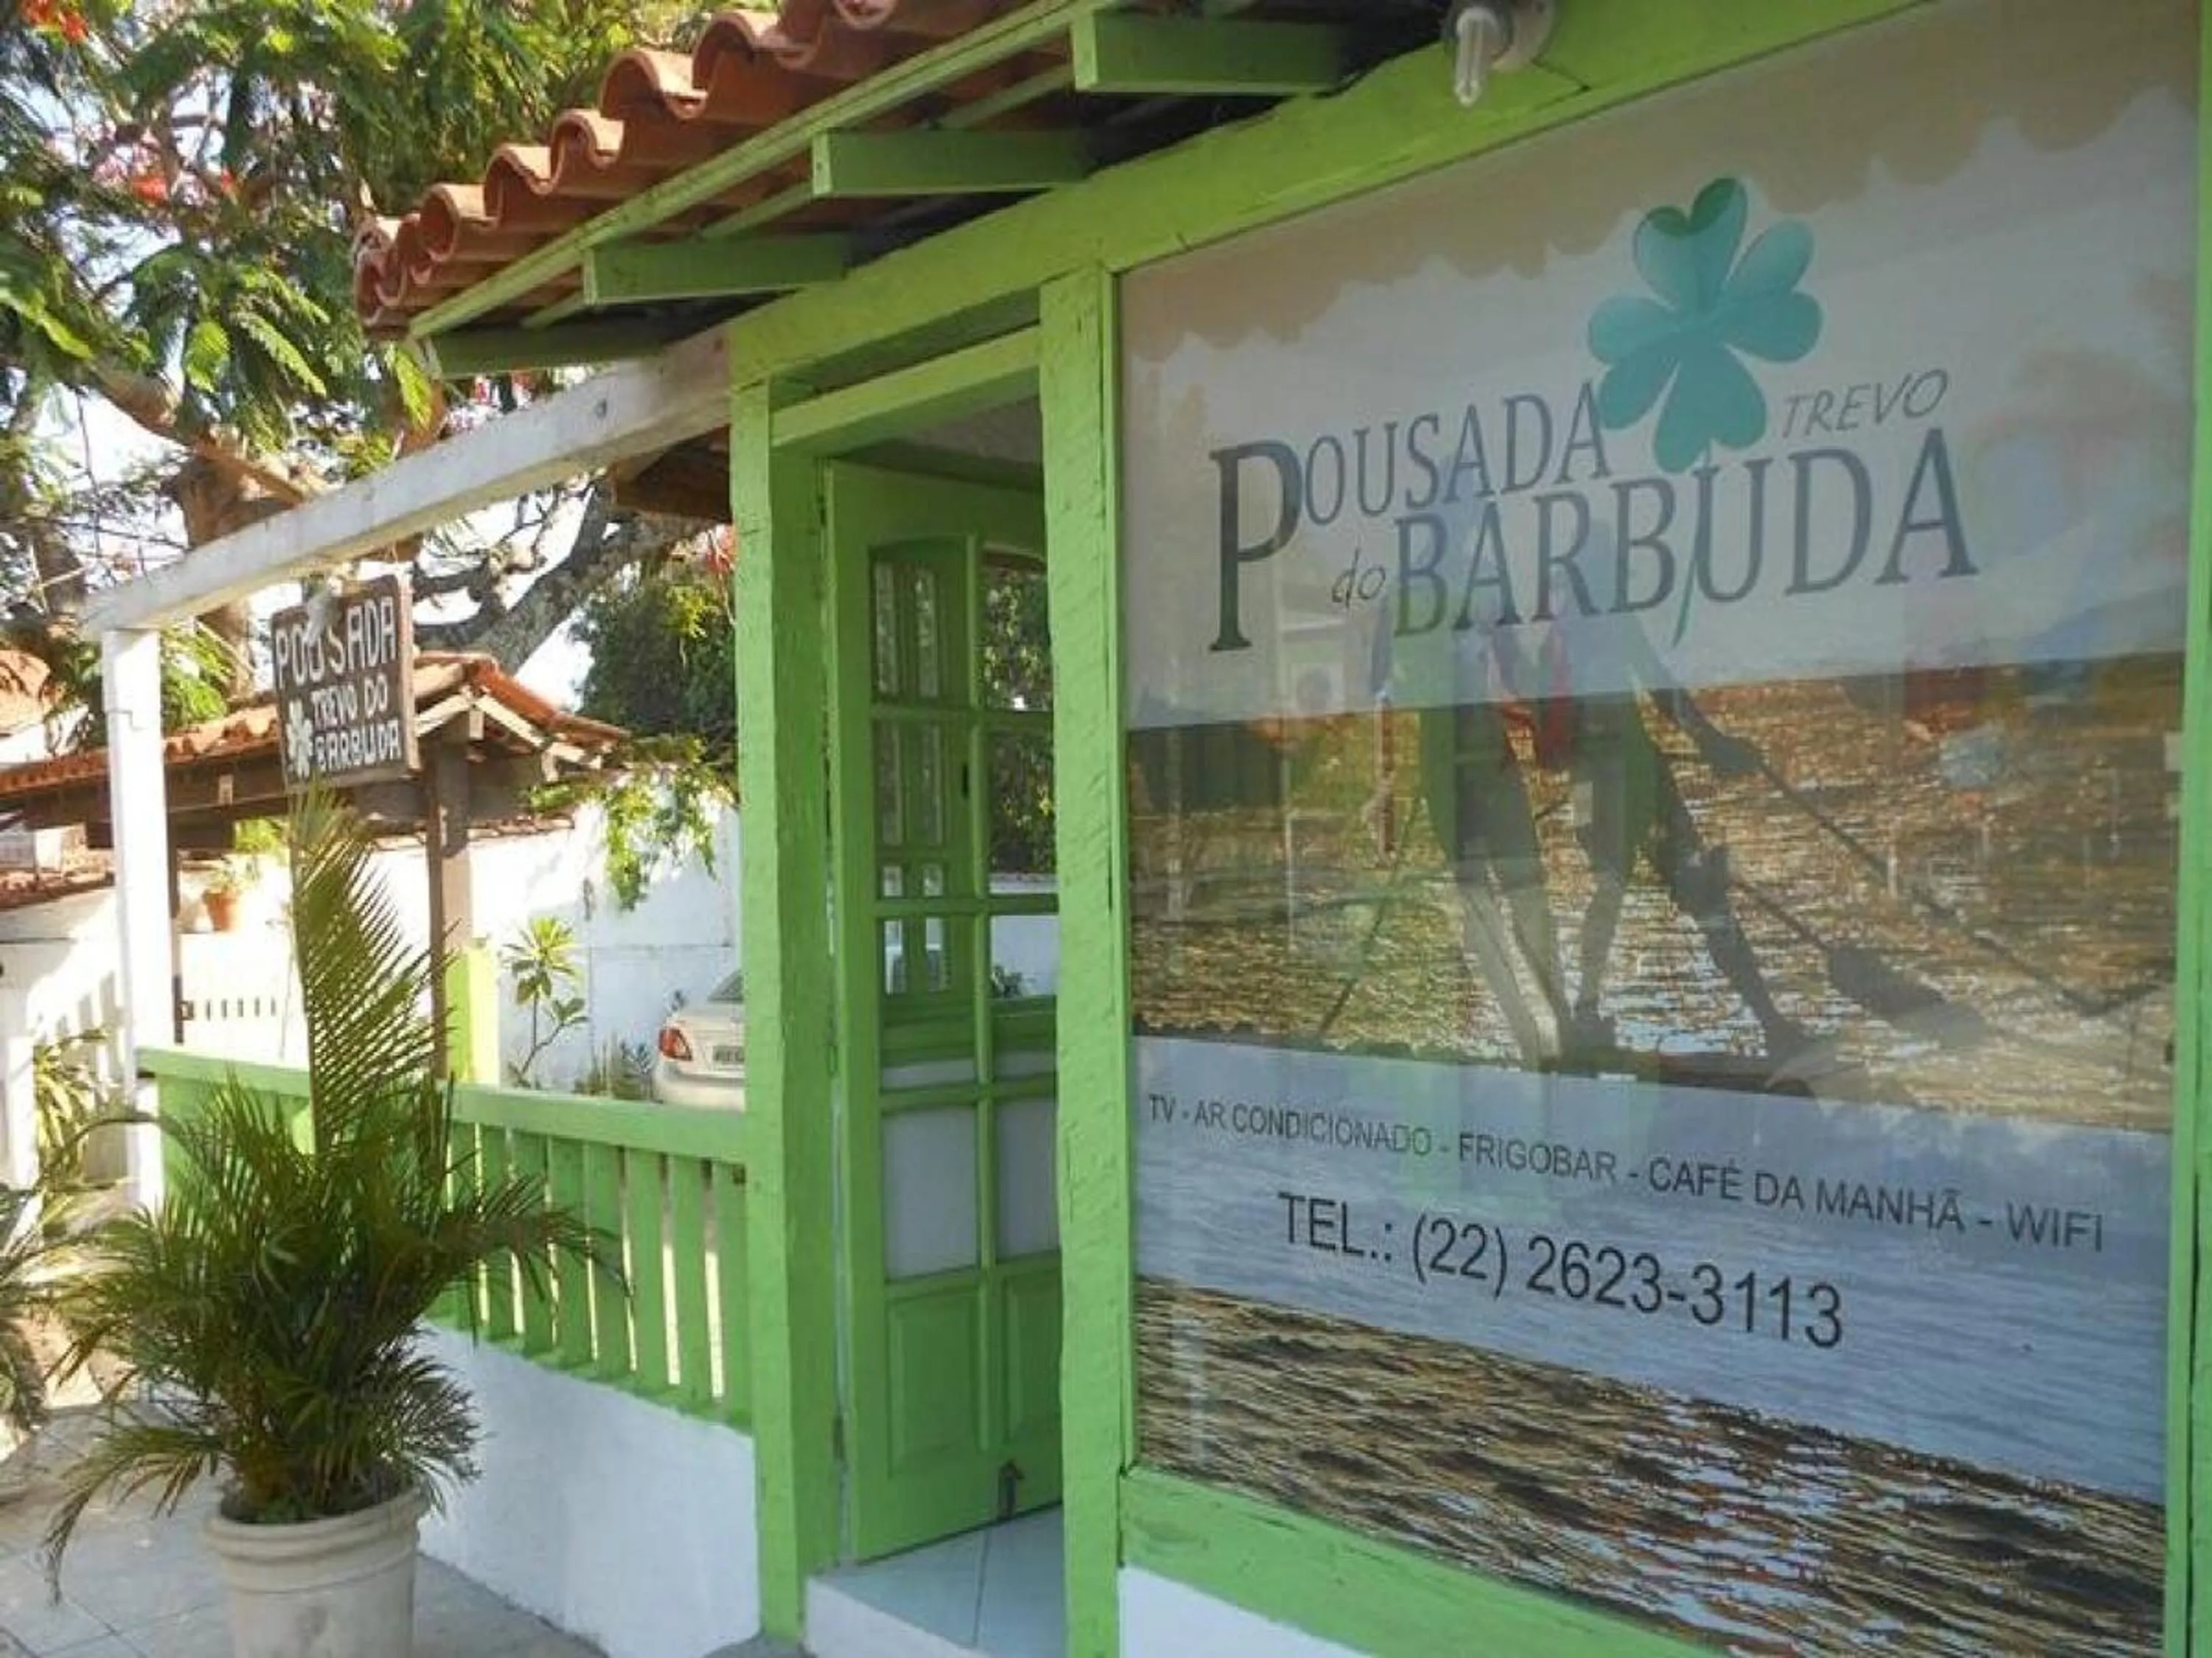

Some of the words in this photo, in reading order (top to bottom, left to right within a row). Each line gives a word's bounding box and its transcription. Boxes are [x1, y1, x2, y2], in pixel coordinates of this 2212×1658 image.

[1209, 381, 1612, 652] POUSADA
[1781, 368, 1949, 439] TREVO
[1331, 547, 1386, 610] do
[1393, 428, 1978, 637] BARBUDA
[275, 594, 397, 690] POUSADA
[364, 673, 389, 720] DO
[1149, 1094, 1175, 1124] TV
[1193, 1099, 1227, 1131] AR
[1232, 1103, 1433, 1156] CONDICIONADO
[1458, 1131, 1616, 1181] FRIGOBAR
[1753, 1173, 1804, 1211] DA
[1815, 1180, 1964, 1233] MANHÃ
[2006, 1201, 2104, 1252] WIFI
[1278, 1191, 1392, 1262] TEL.:
[1413, 1213, 1507, 1300] (22)
[1526, 1235, 1843, 1350] 2623-3113
